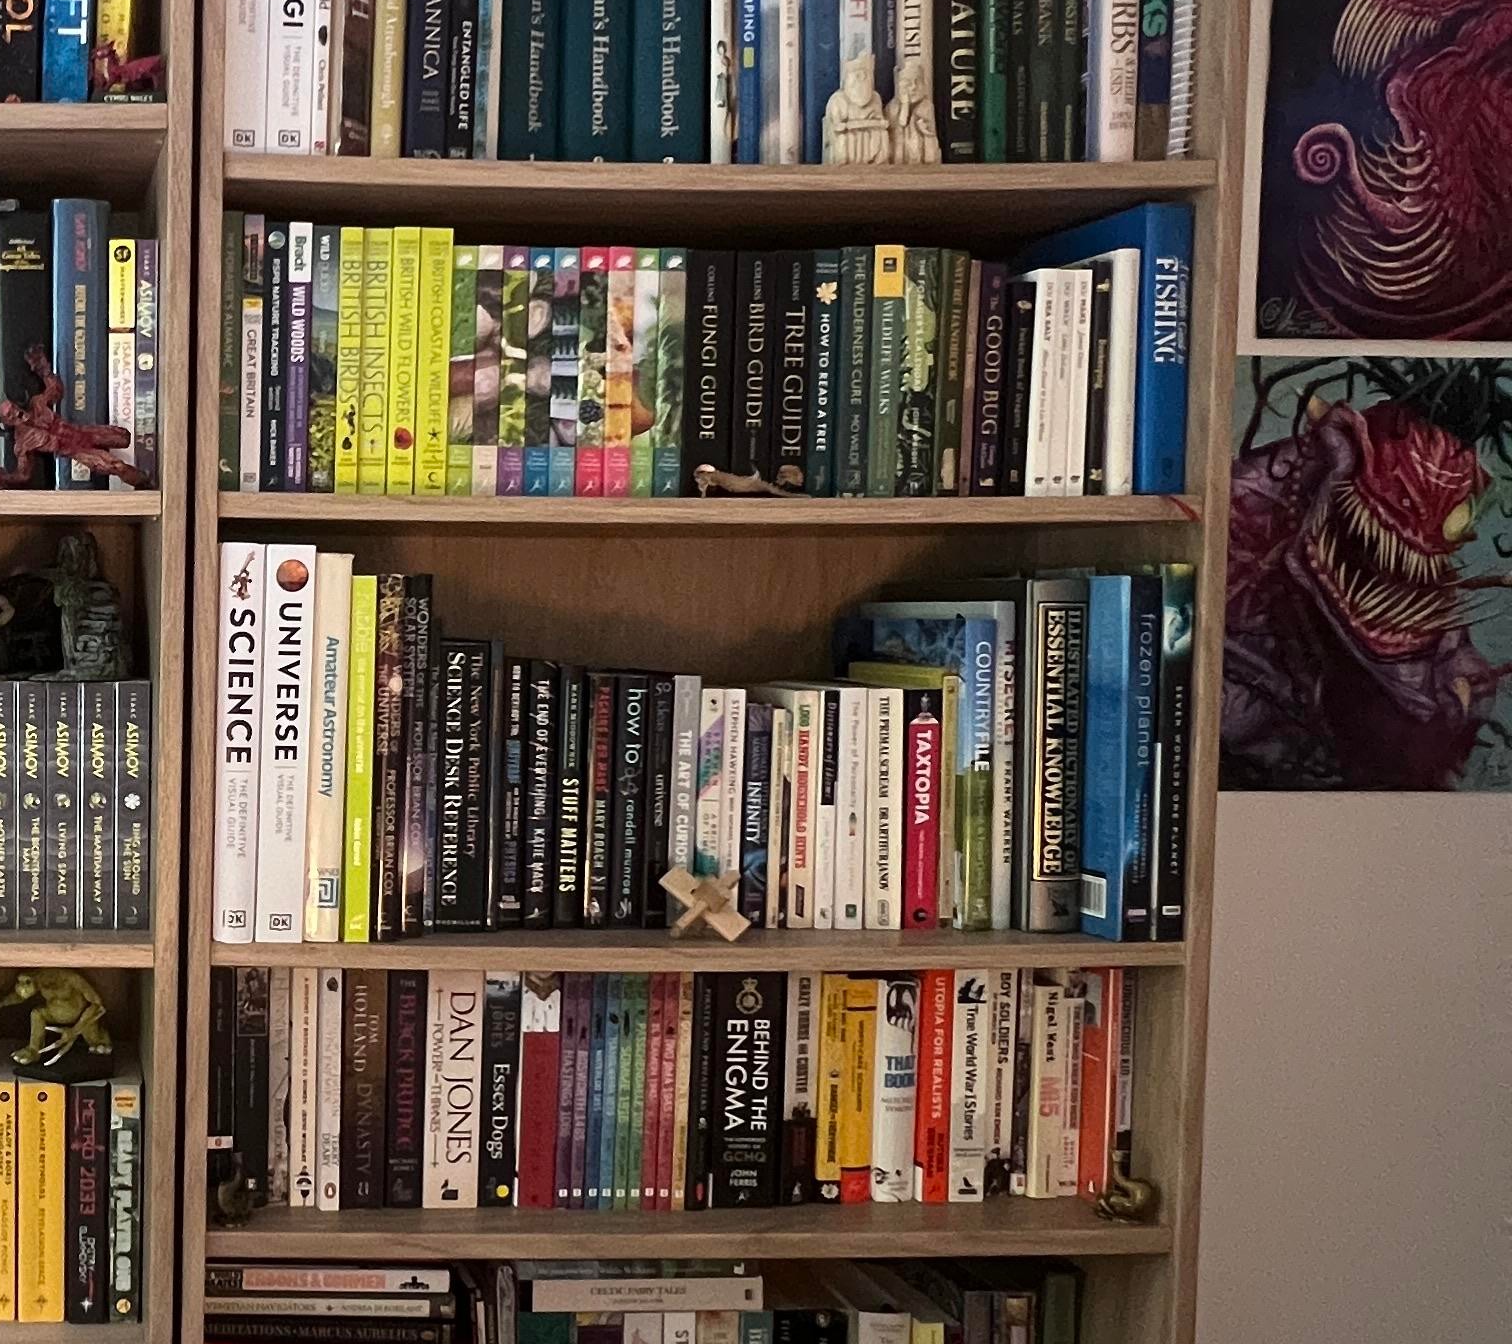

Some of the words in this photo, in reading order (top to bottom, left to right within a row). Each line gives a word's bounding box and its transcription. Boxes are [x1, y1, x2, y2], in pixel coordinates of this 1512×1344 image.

[592, 30, 610, 136] Handbook
[293, 235, 306, 271] Bradt
[366, 260, 387, 336] BRITISH
[1154, 258, 1177, 362] FISHING
[785, 307, 805, 368] TREE
[986, 316, 1003, 383] GOOD
[363, 344, 385, 434] INSECTS
[782, 374, 804, 456] GUIDE
[982, 389, 999, 436] BUG
[227, 607, 255, 764] SCIENCE
[274, 603, 303, 762] UNIVERSE
[323, 637, 339, 708] Amateur
[1045, 610, 1065, 730] ESSENTIAL
[1138, 613, 1157, 687] frozen
[974, 642, 991, 771] COUNTRYFILE
[1135, 695, 1154, 768] planet
[319, 710, 337, 798] Astronomy
[915, 730, 932, 825] TAXTOPIA
[1043, 738, 1064, 873] KNOWLEDGE
[450, 992, 476, 1061] DAN
[933, 977, 946, 1027] UTOPIA
[724, 1020, 748, 1132] ENIGMA
[754, 1020, 771, 1088] BEHIND
[932, 1031, 944, 1051] FOR
[446, 1078, 473, 1165] JONES
[491, 1064, 510, 1112] Essex
[751, 1097, 768, 1131] THE
[931, 1053, 944, 1119] REALISTS
[487, 1116, 509, 1159] Dogs
[723, 1151, 766, 1162] GCHQ
